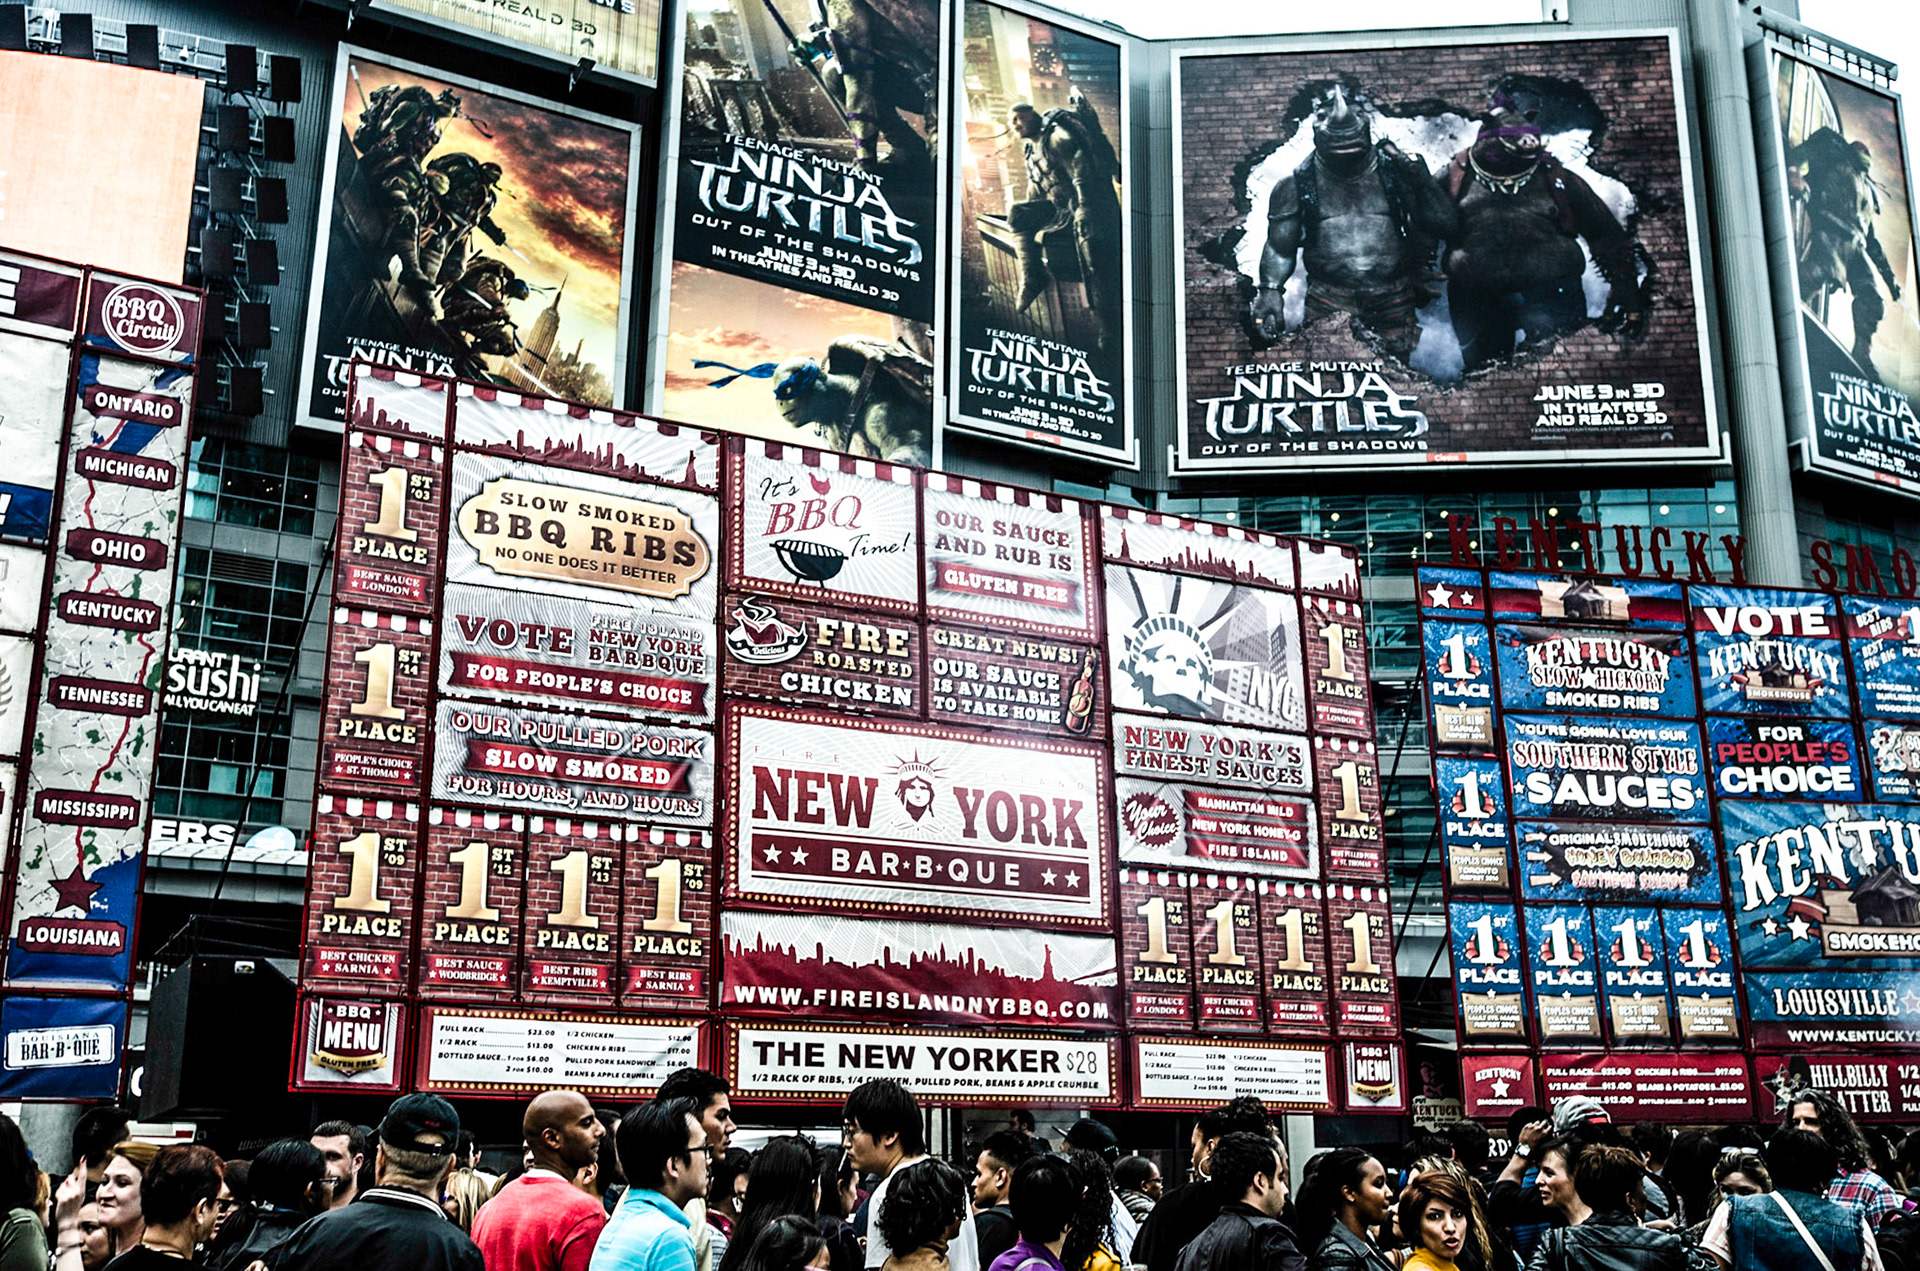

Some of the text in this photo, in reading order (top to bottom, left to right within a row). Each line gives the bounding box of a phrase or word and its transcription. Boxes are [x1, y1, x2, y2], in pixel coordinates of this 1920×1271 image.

[723, 132, 883, 185] TEENAGE MUTANT
[728, 146, 897, 218] NINJA
[690, 159, 923, 265] TURTLES
[692, 213, 920, 281] OUT OF THE SHADOWS
[757, 246, 804, 269] JUNE
[805, 257, 817, 270] 3
[831, 263, 856, 280] 3D
[109, 295, 166, 320] BBQ
[116, 318, 177, 343] Circuit
[346, 337, 454, 363] TEENAGE MUTANT
[1225, 362, 1383, 376] TEENAGE MUTANT
[1233, 372, 1401, 400] NINJA
[1534, 385, 1596, 401] JUNE
[1597, 385, 1613, 399] 3
[1633, 383, 1665, 398] 3D
[95, 392, 174, 419] ONTARIO
[1196, 396, 1428, 441] TURTLES
[1536, 414, 1575, 426] AND
[1579, 414, 1624, 426] REAL
[1644, 412, 1667, 424] 3D
[1543, 401, 1657, 414] IN THEATRES
[1202, 440, 1428, 455] OUT OF THE SHADOWS
[85, 456, 169, 484] MICHIGAN
[759, 477, 799, 500] It's
[501, 492, 675, 532] SLOW SMOKED
[762, 495, 862, 536] BBQ
[474, 509, 696, 567] BBQ RIBS
[936, 510, 1070, 548] OUR SAUCE
[91, 538, 146, 562] OHIO
[849, 533, 910, 558] Time!
[936, 534, 1072, 571] AND RUB IS
[1448, 514, 1747, 584] KENTUCKY
[495, 546, 676, 584] NO ONE DOES IT BETTER
[944, 569, 1068, 603] GLUTEN FREE
[67, 599, 156, 624] KENTUCKY
[1704, 606, 1831, 637] VOTE
[454, 614, 574, 654] VOTE
[589, 628, 705, 658] NEW YORK
[816, 618, 909, 658] FIRE
[933, 629, 1078, 664] GREAT NEWS!
[589, 646, 705, 675] BARBQUE
[813, 650, 912, 678] ROASTED
[1527, 637, 1671, 680] KENTUCKY
[1709, 636, 1841, 685] KENTUCKY
[166, 654, 261, 703] sushi
[467, 663, 691, 704] FOR PEOPLE'S CHOICE
[933, 658, 1060, 690] OUR SAUCE
[1532, 666, 1665, 694] SLOW HICKORY
[59, 685, 145, 709] TENNESSEE
[780, 673, 912, 707] CHICKEN
[933, 678, 1061, 707] IS AVAILABLE
[1546, 692, 1660, 711] SMOKED RIBS
[1747, 687, 1812, 701] SMOKEHOUSE
[933, 696, 1061, 724] TO TAKE HOME
[453, 711, 702, 759] OUR PULLED PORK
[1126, 726, 1301, 766] NEW YORK'S
[1516, 723, 1688, 741] YOU'RE GONNA LOVE OUR
[1759, 726, 1803, 742] FOR
[485, 747, 670, 786] SLOW SMOKED
[1513, 740, 1698, 774] SOUTHERN STYLE
[1718, 742, 1850, 764] PEOPLE'S
[1126, 750, 1303, 786] FINEST SAUCES
[1720, 765, 1855, 794] CHOICE
[449, 776, 702, 816] FOR HOURS, AND HOURS
[1526, 772, 1694, 810] SAUCES
[42, 799, 135, 820] MISSISSIPPI
[752, 766, 1087, 849] NEW YORK
[1126, 801, 1167, 822] Your
[1198, 797, 1293, 817] MANHATTAN MILD
[1138, 820, 1176, 840] Choice
[1549, 832, 1690, 848] ORIGINAL SMOKEHOUSE
[1208, 844, 1288, 862] FIRE ISLAND
[25, 926, 121, 947] LOUISIANA
[322, 915, 401, 938] PLACE
[320, 951, 395, 964] BEST CHICKEN
[335, 963, 378, 975] SARNIA
[734, 986, 1109, 1019] WWW.FIREISLANDNYBBQ.COM
[1773, 989, 1900, 1016] LOUISVILLE
[324, 1021, 381, 1051] MENU
[753, 1041, 1097, 1074] THE NEW YORKER $28
[752, 1074, 845, 1085] 1/2 RACK OF RIBS,
[915, 1078, 951, 1086] PULLED
[953, 1078, 982, 1088] PORK,
[985, 1079, 1016, 1088] BEANS
[1027, 1080, 1055, 1088] APPLE
[1057, 1080, 1099, 1089] CRUMBLE
[1475, 1067, 1521, 1082] KENTUCKY
[1810, 1065, 1888, 1088] HILLBILLY
